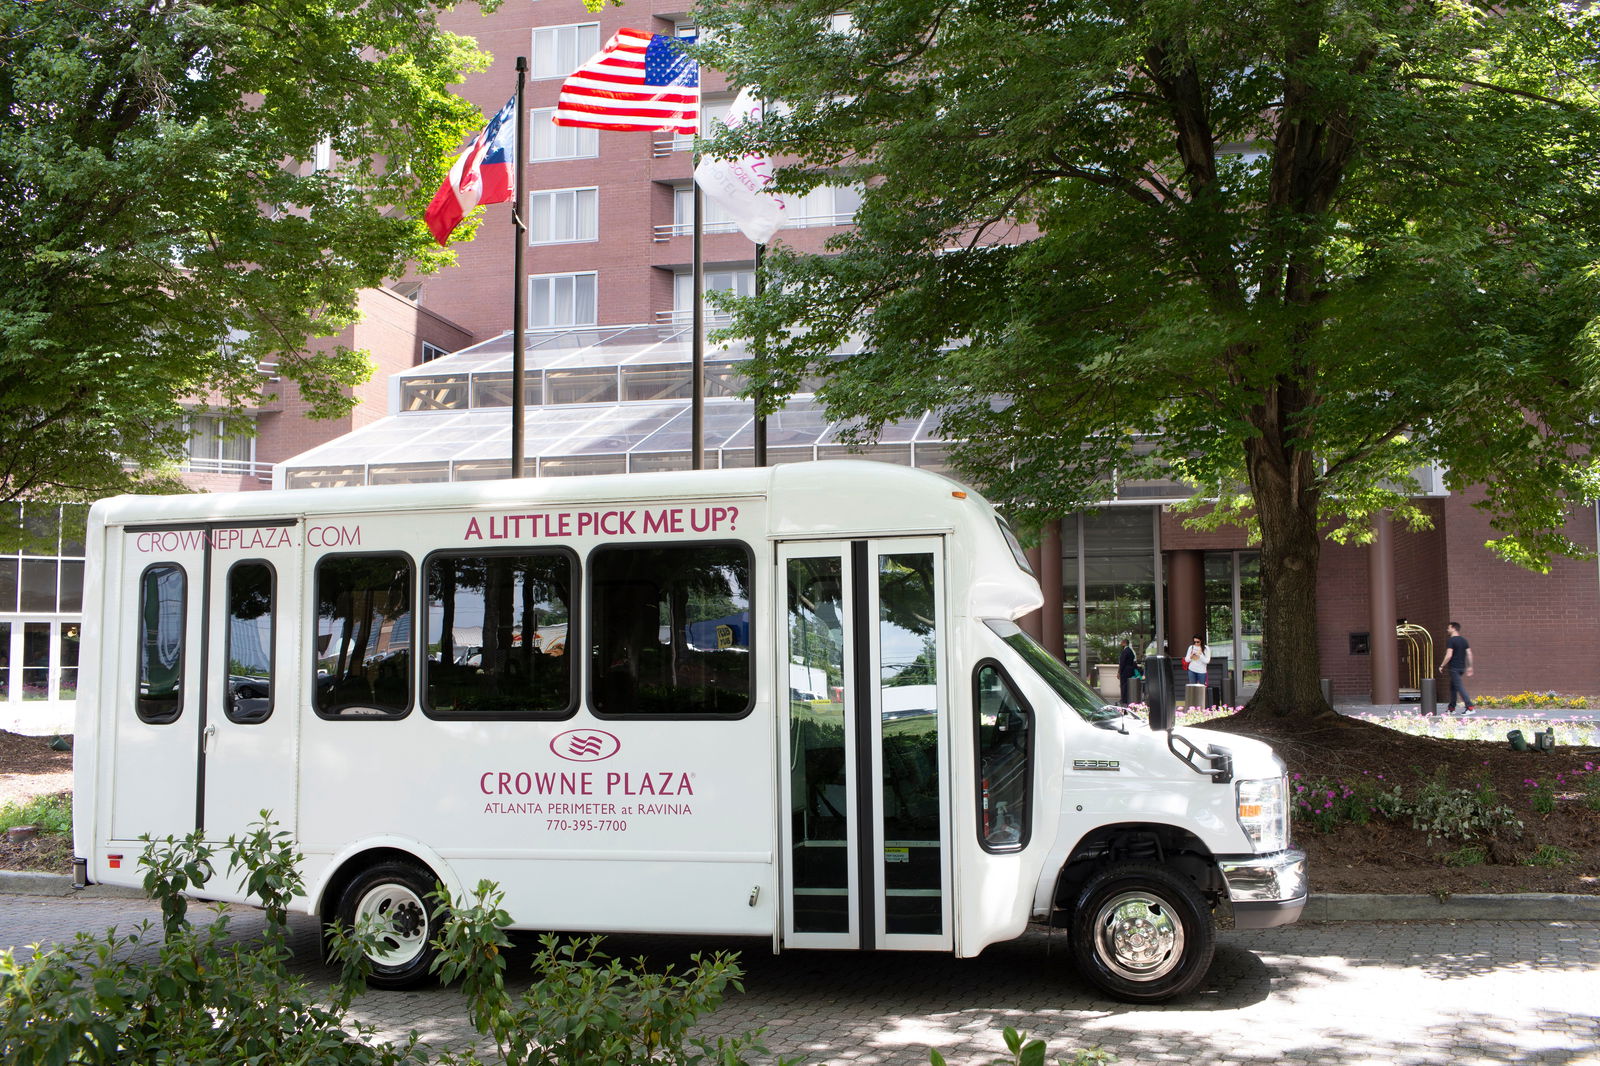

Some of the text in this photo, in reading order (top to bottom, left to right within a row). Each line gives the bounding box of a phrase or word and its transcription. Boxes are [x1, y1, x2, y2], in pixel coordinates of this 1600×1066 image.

[464, 506, 739, 541] A LITTLE PICK ME UP?
[480, 771, 593, 795] CROWNE
[484, 802, 692, 815] ATLANTA PERIMETER at RAVINIA
[546, 819, 627, 832] 770-395-7700
